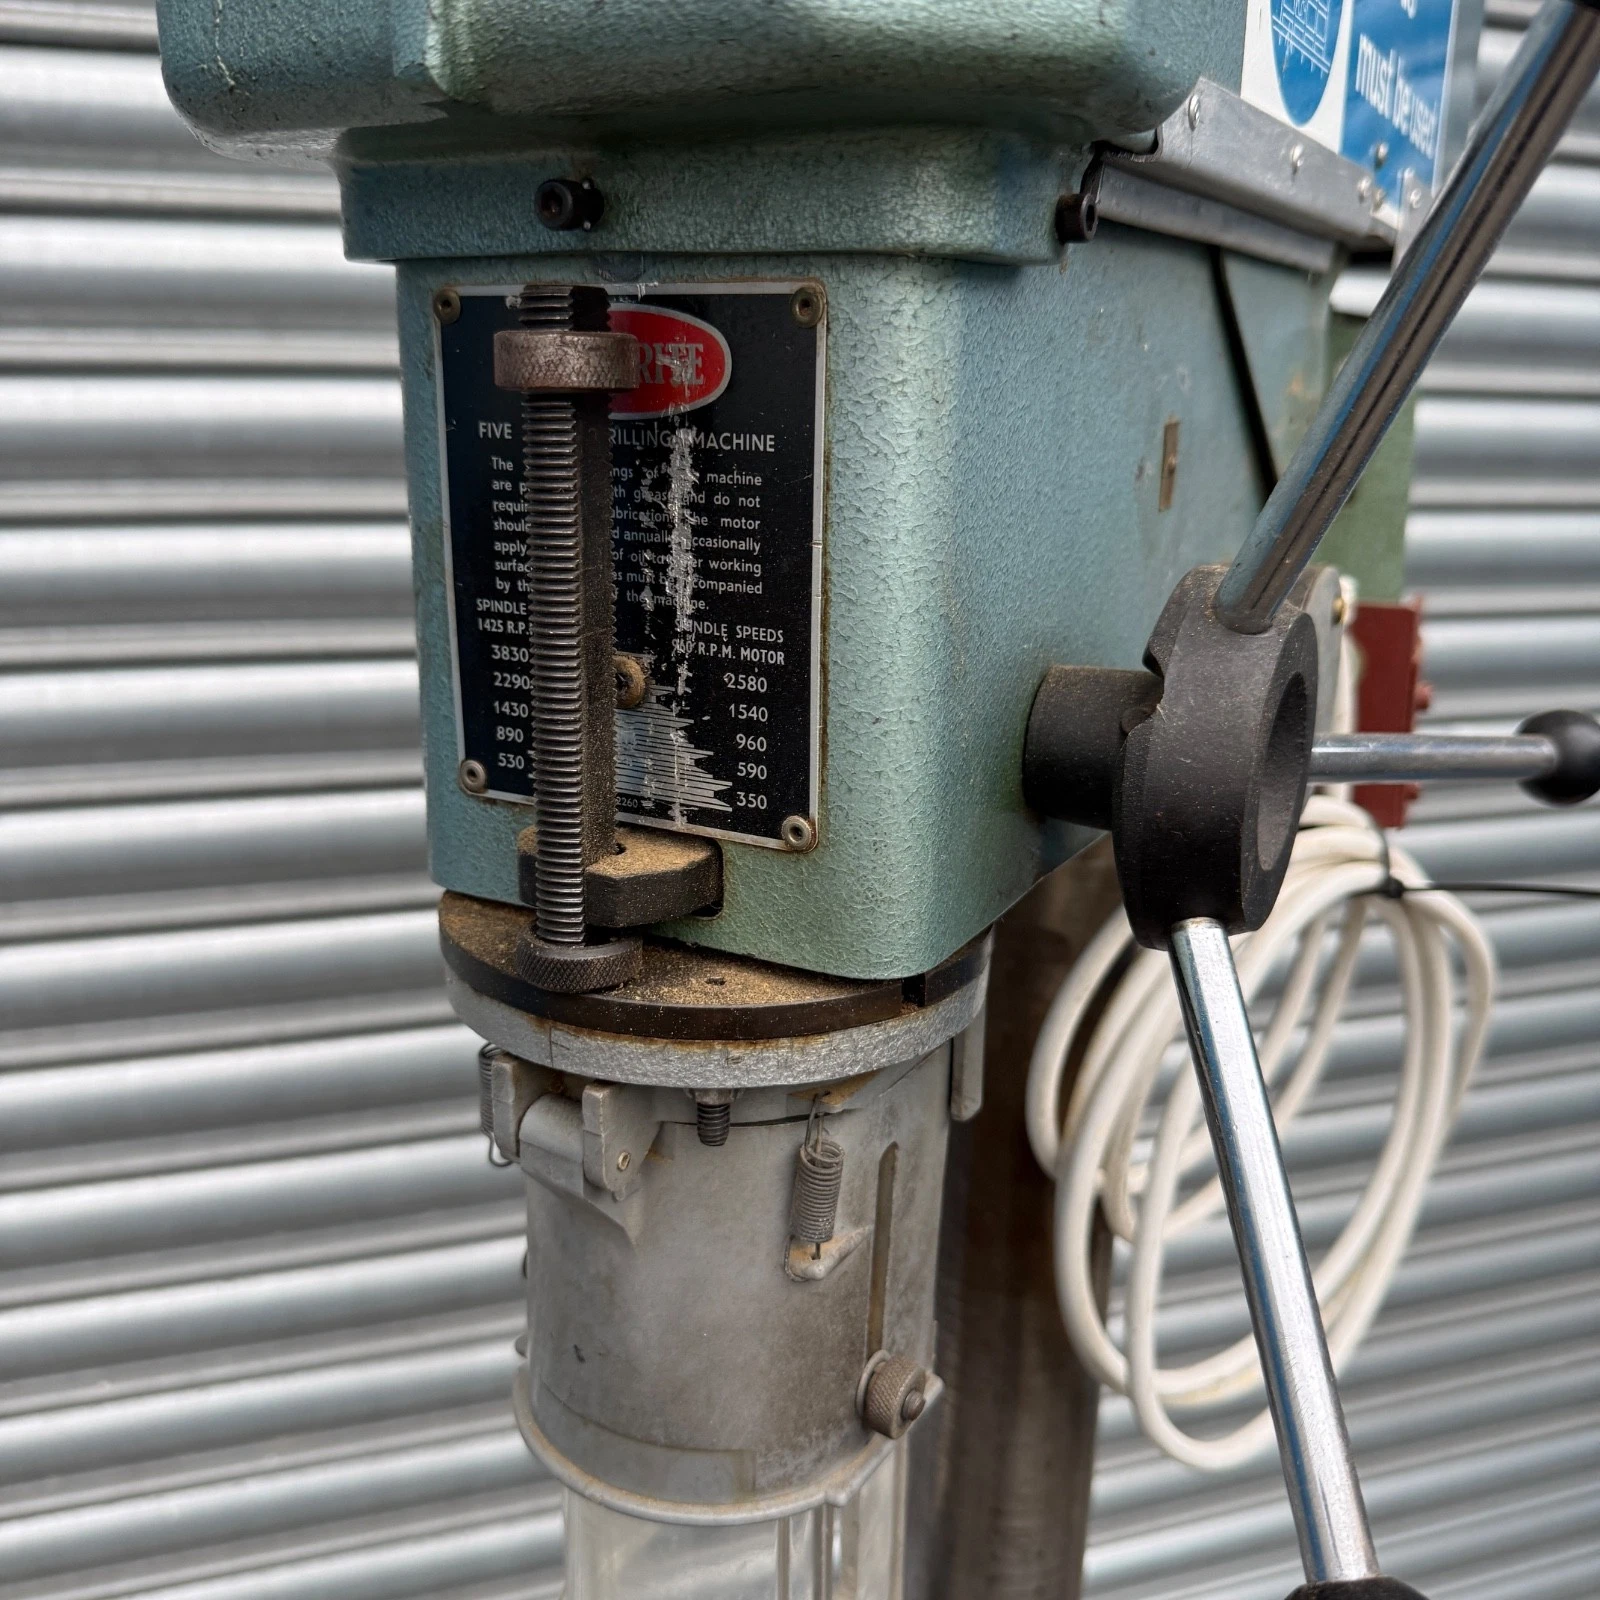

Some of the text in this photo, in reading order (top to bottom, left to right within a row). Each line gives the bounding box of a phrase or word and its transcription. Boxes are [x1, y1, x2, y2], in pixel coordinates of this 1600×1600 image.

[1355, 32, 1397, 120] must
[1392, 56, 1413, 136] be
[478, 421, 513, 441] FIVE
[608, 428, 775, 452] RILLING MACHINE
[491, 456, 514, 471] The
[706, 470, 762, 486] machine
[492, 479, 513, 491] are
[713, 491, 730, 506] do
[738, 495, 761, 508] not
[720, 516, 761, 530] motor
[692, 535, 761, 556] ccasionally
[494, 540, 527, 556] apply
[708, 557, 762, 577] working
[496, 577, 511, 594] by
[476, 598, 527, 616] SPINDLE
[477, 617, 504, 633] 1425
[735, 625, 784, 643] SPEEDS
[491, 644, 529, 663] 3830
[698, 641, 736, 659] R.P.M.
[740, 647, 785, 666] MOTOR
[493, 671, 531, 690] 2290
[725, 673, 768, 693] 2580
[493, 700, 529, 718] 1430
[728, 703, 768, 722] 1540
[496, 725, 524, 743] 890
[736, 733, 767, 752] 960
[497, 752, 525, 770] 530
[736, 762, 768, 780] 590
[736, 791, 768, 810] 350
